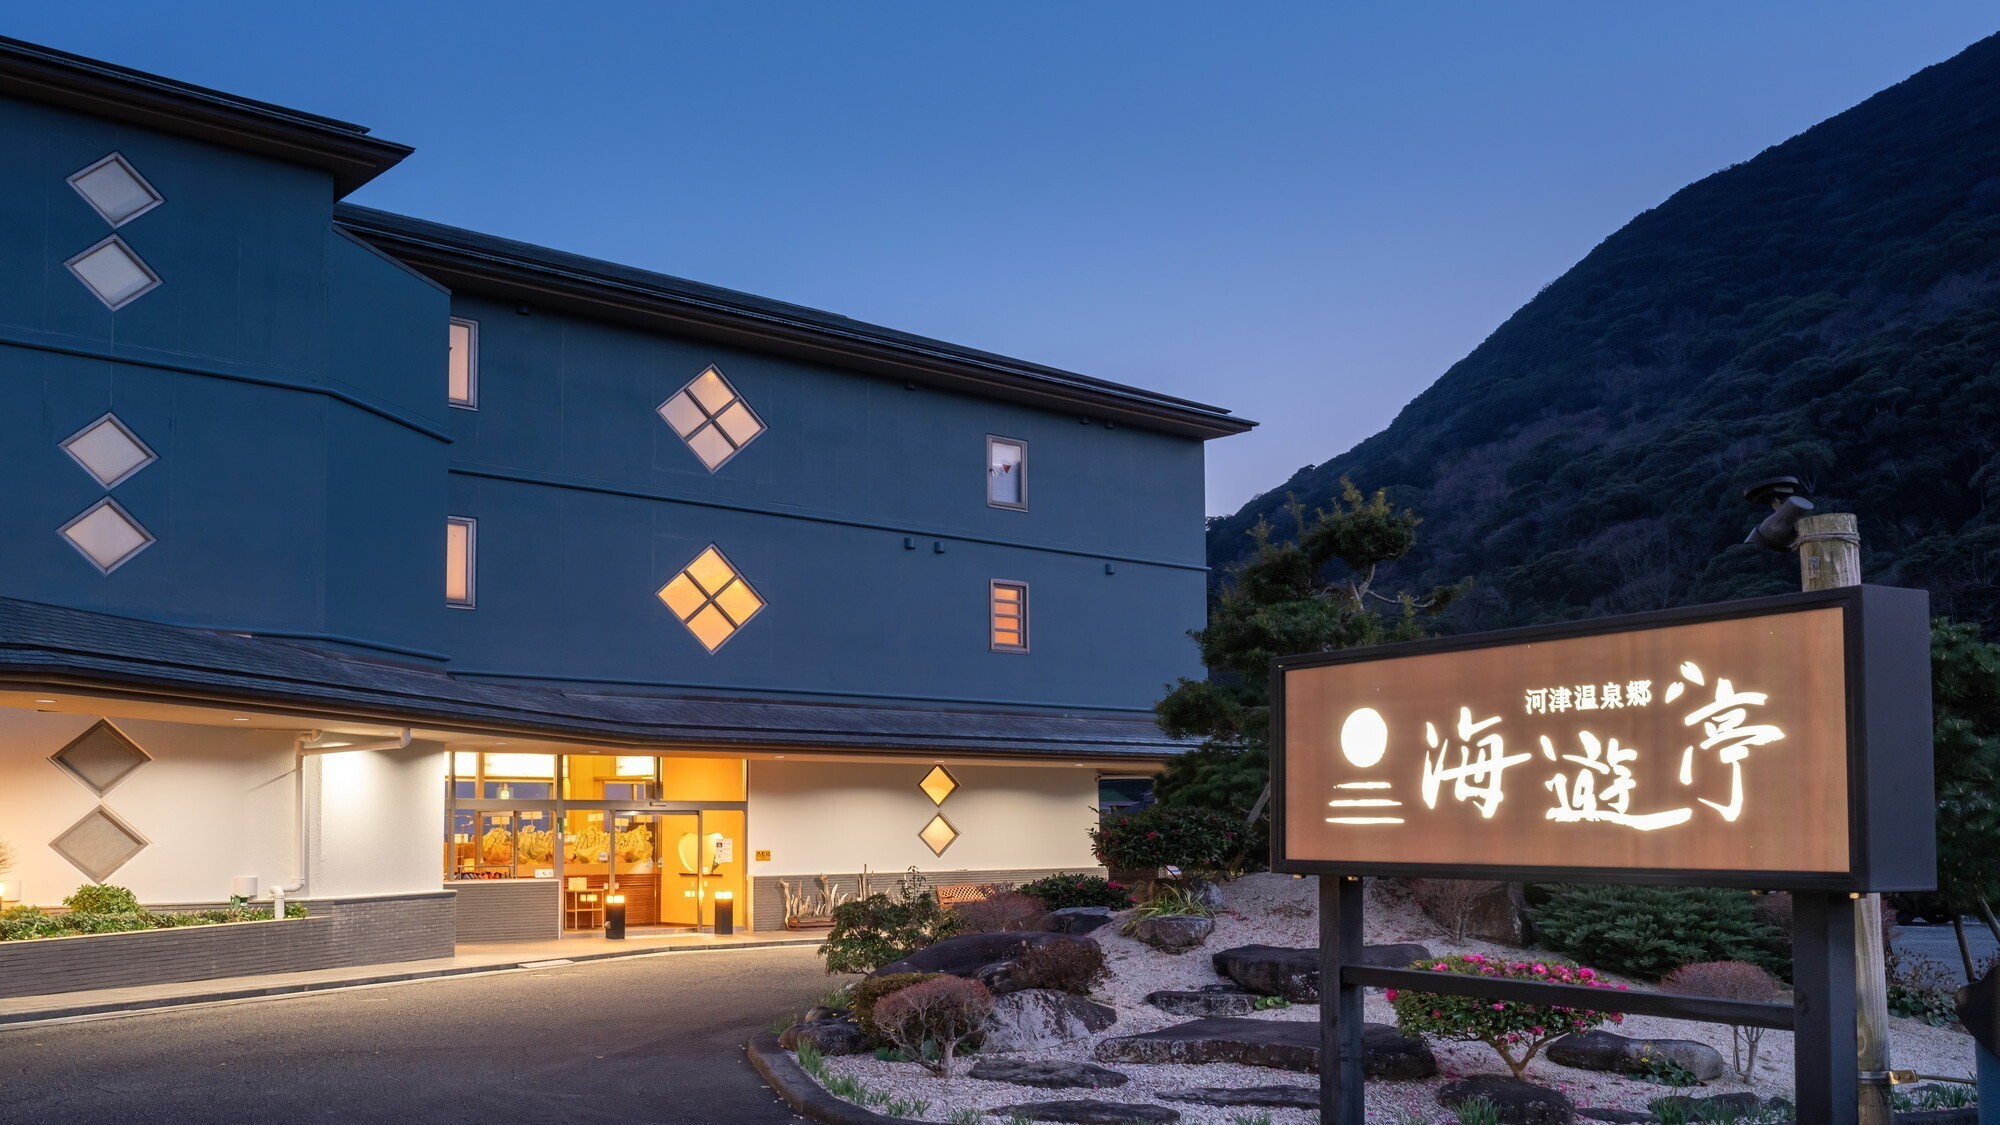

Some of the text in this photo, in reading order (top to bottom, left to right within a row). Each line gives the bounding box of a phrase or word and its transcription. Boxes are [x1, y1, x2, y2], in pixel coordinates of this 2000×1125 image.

[1421, 661, 1786, 831] 海遊亭
[1524, 679, 1653, 715] 河津温泉郷
